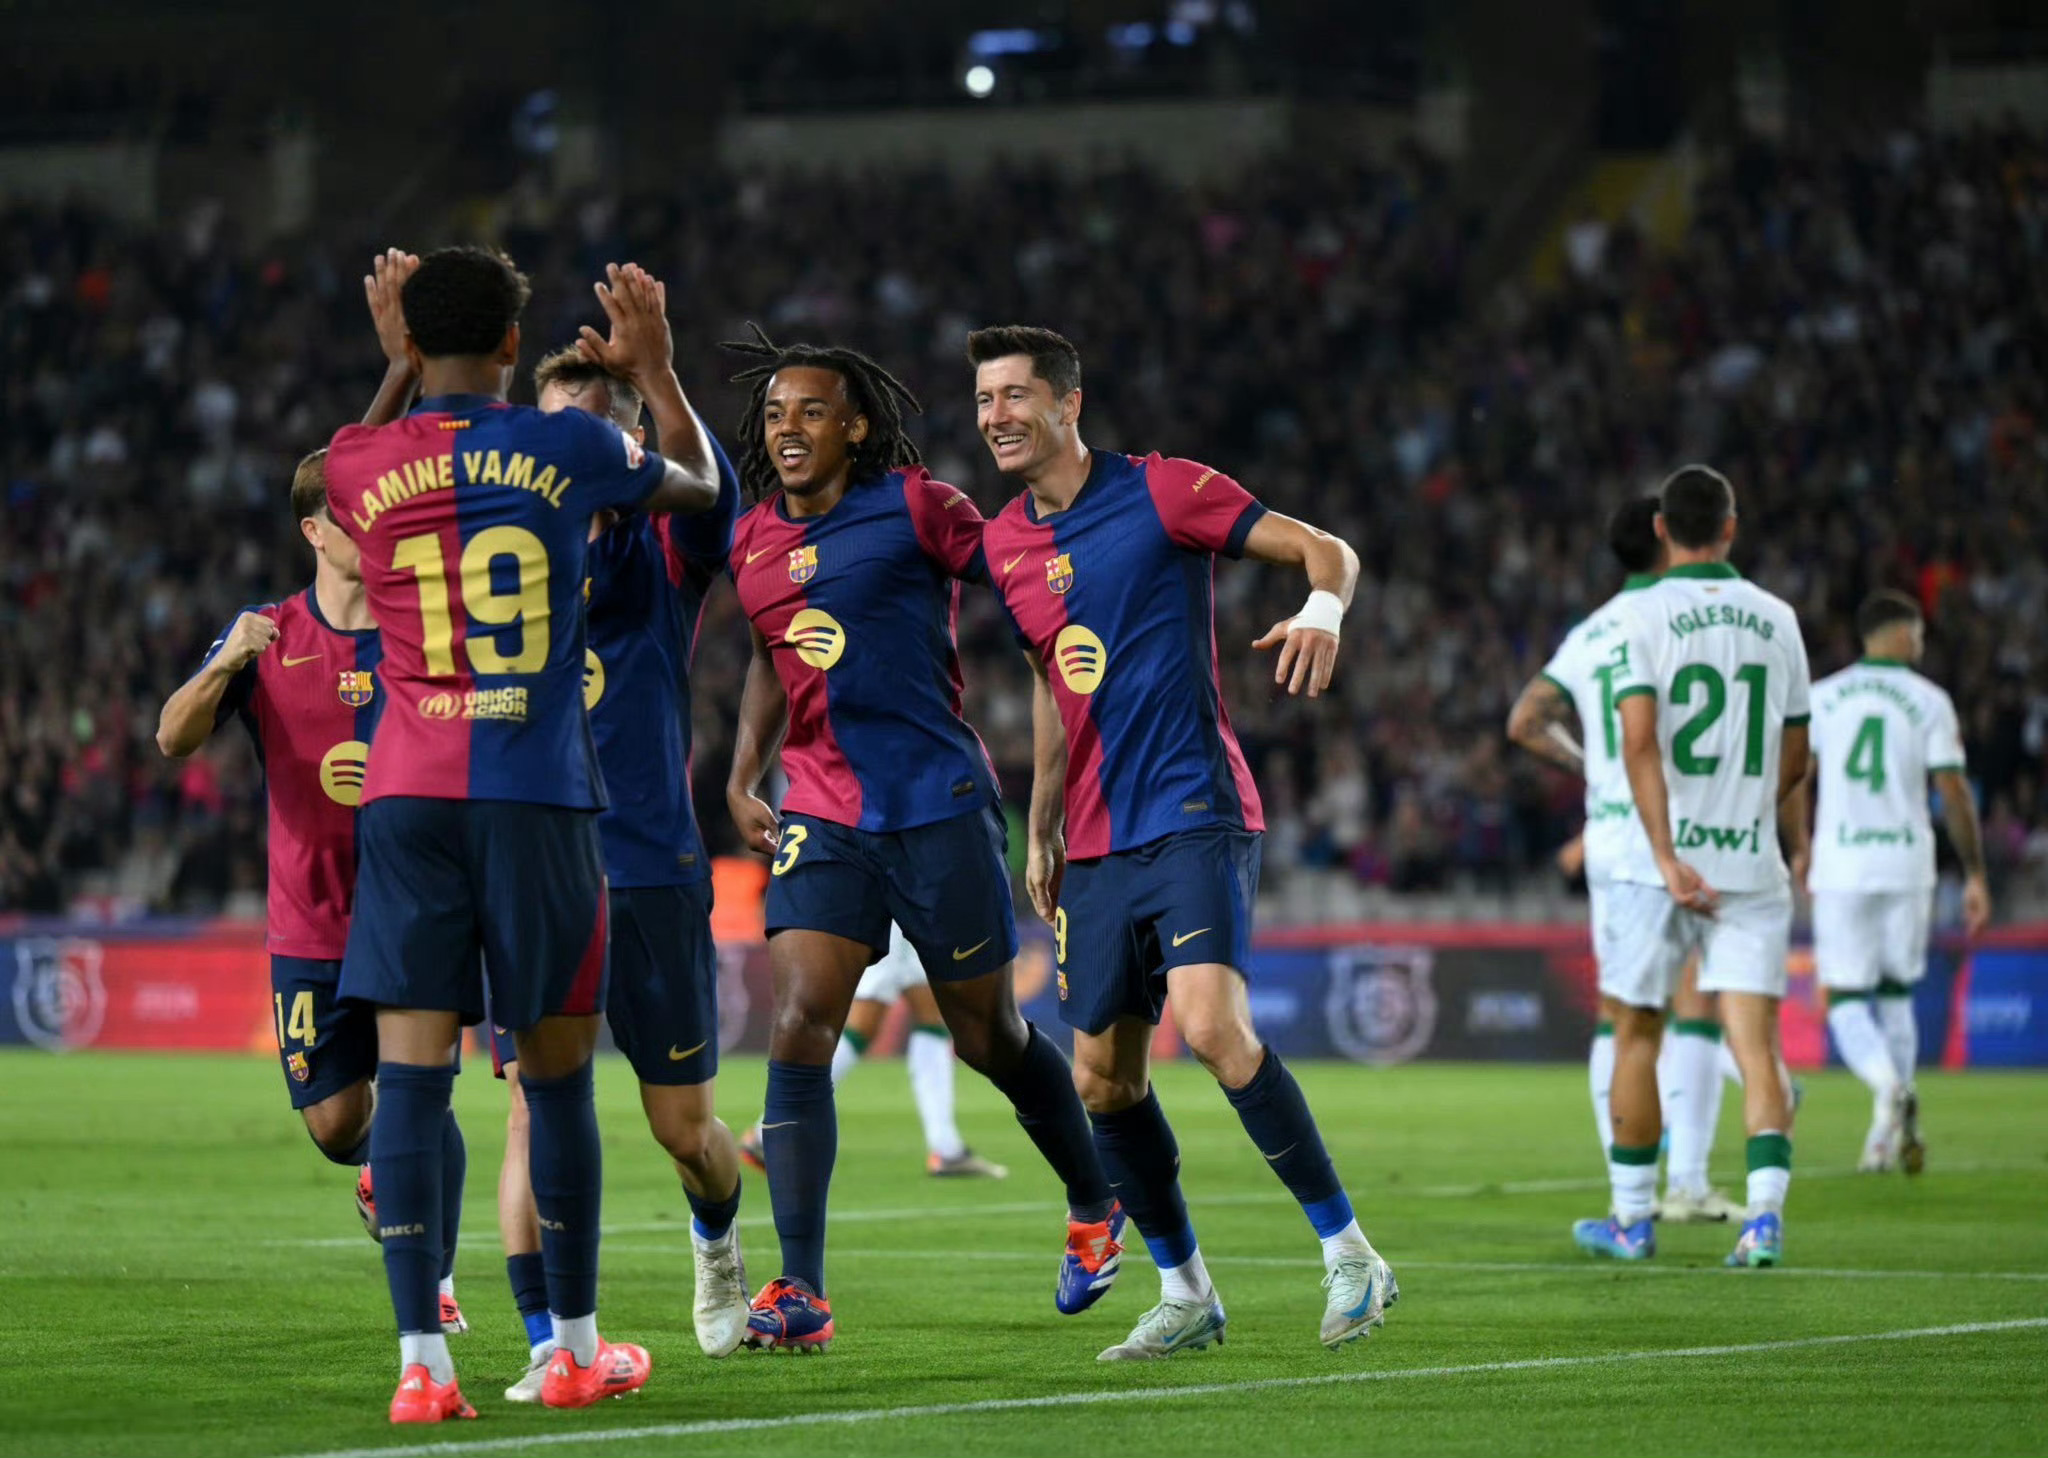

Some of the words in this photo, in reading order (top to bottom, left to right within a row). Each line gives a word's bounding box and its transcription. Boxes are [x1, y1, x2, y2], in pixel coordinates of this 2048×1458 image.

[352, 454, 455, 532] LAMINE
[463, 450, 571, 508] YAMAL
[391, 525, 551, 676] 19
[1669, 605, 1775, 640] IGLESIAS
[462, 700, 527, 719] ACNUR
[464, 686, 527, 706] UNHCR
[1592, 666, 1618, 760] 1
[1669, 663, 1767, 776] 21
[1845, 716, 1886, 794] 4
[772, 824, 808, 876] 3
[275, 990, 317, 1049] 14
